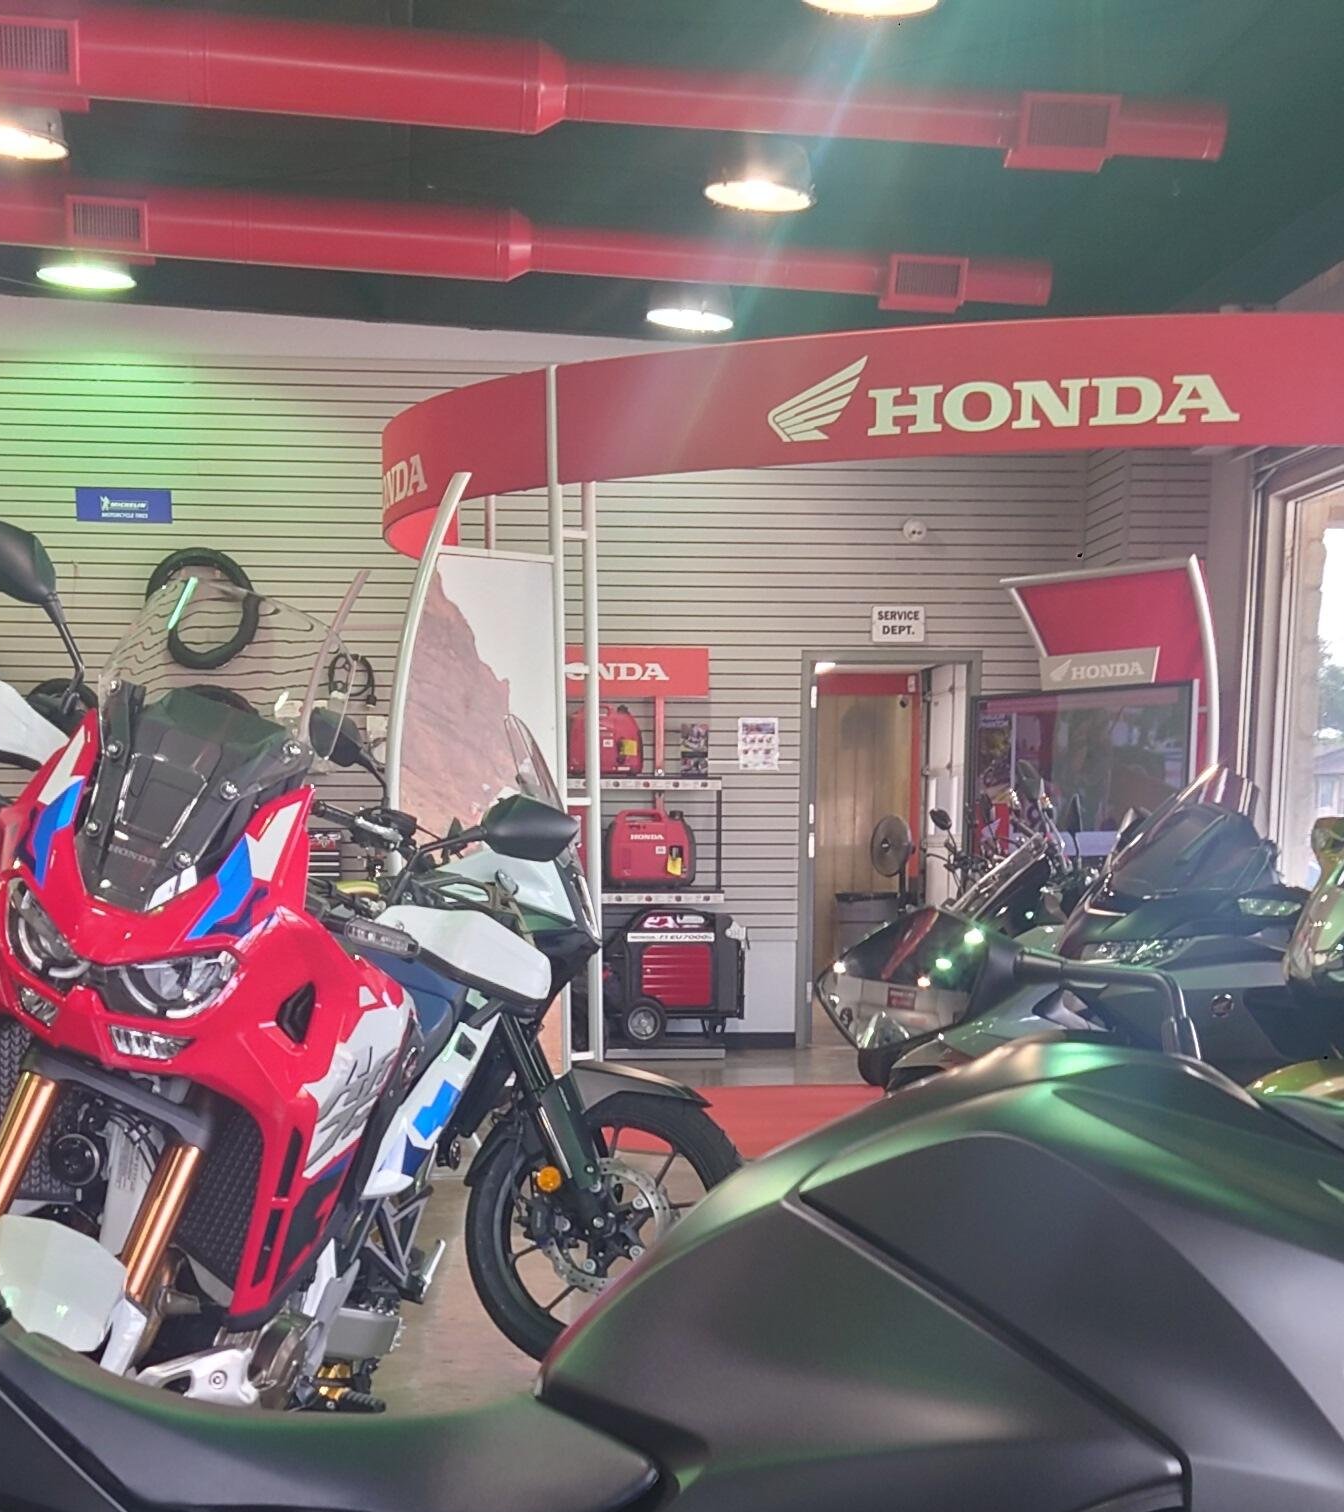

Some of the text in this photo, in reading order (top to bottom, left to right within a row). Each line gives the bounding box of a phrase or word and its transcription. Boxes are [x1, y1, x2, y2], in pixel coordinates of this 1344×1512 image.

[867, 374, 1241, 436] HONDA
[382, 453, 429, 509] NDA
[877, 610, 920, 621] SERVICE
[881, 625, 915, 635] DEPT.
[1070, 660, 1145, 681] HONDA
[107, 843, 158, 867] HONDA
